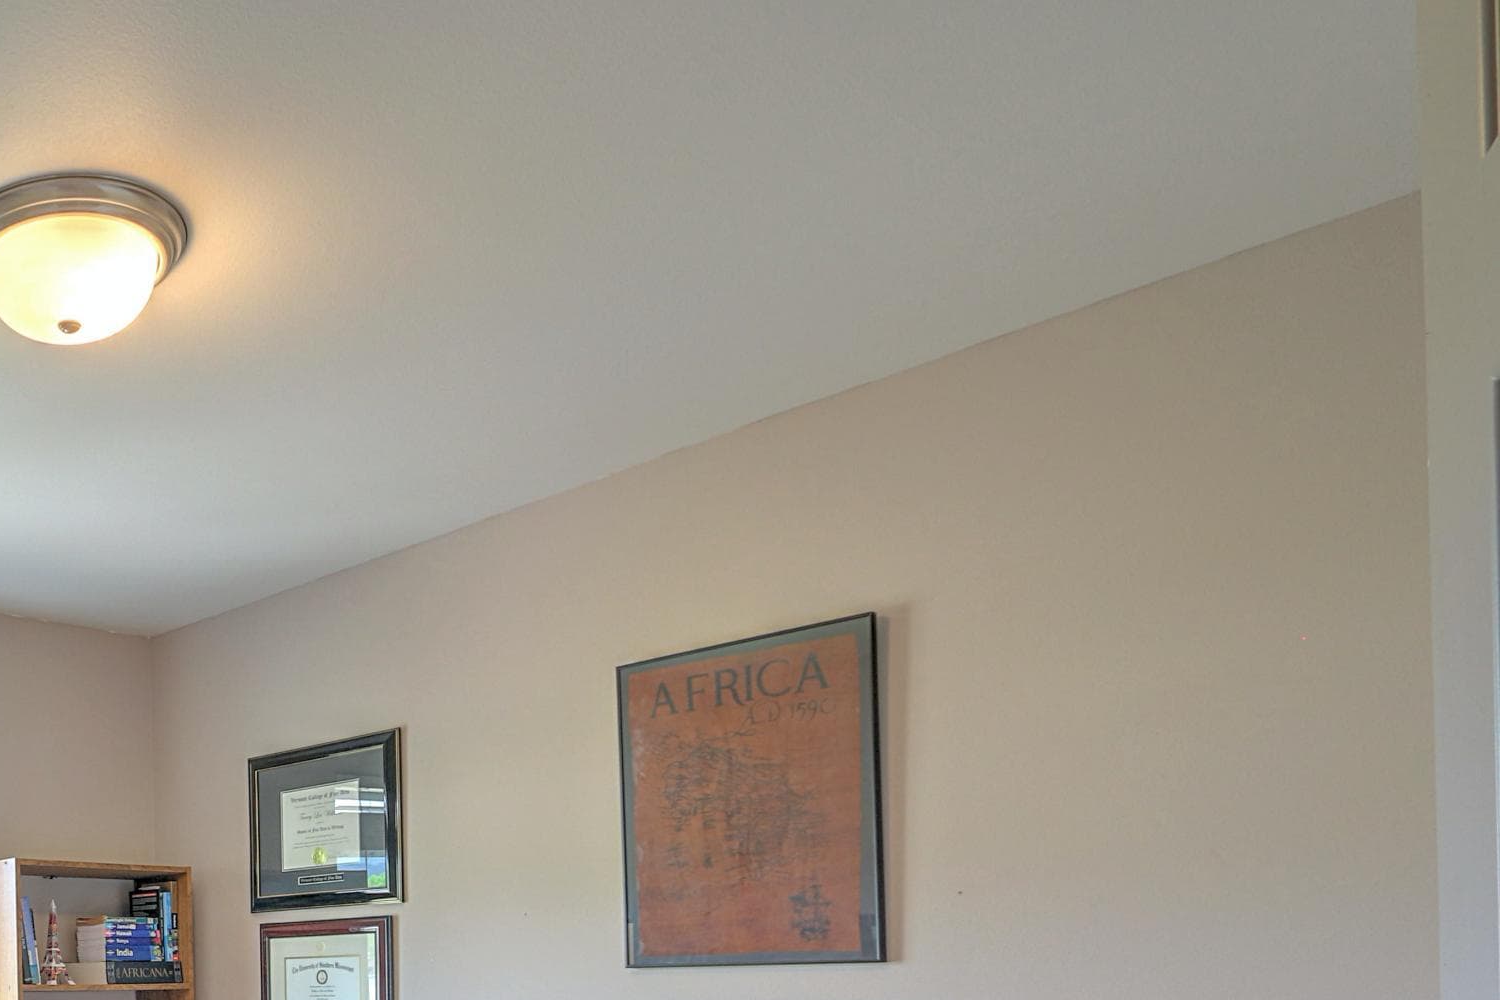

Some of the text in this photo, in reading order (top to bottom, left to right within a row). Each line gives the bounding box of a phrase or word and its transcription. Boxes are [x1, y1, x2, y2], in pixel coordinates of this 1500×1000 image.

[650, 652, 830, 719] AFRICA
[116, 948, 133, 956] India
[122, 967, 168, 978] AFRICANA
